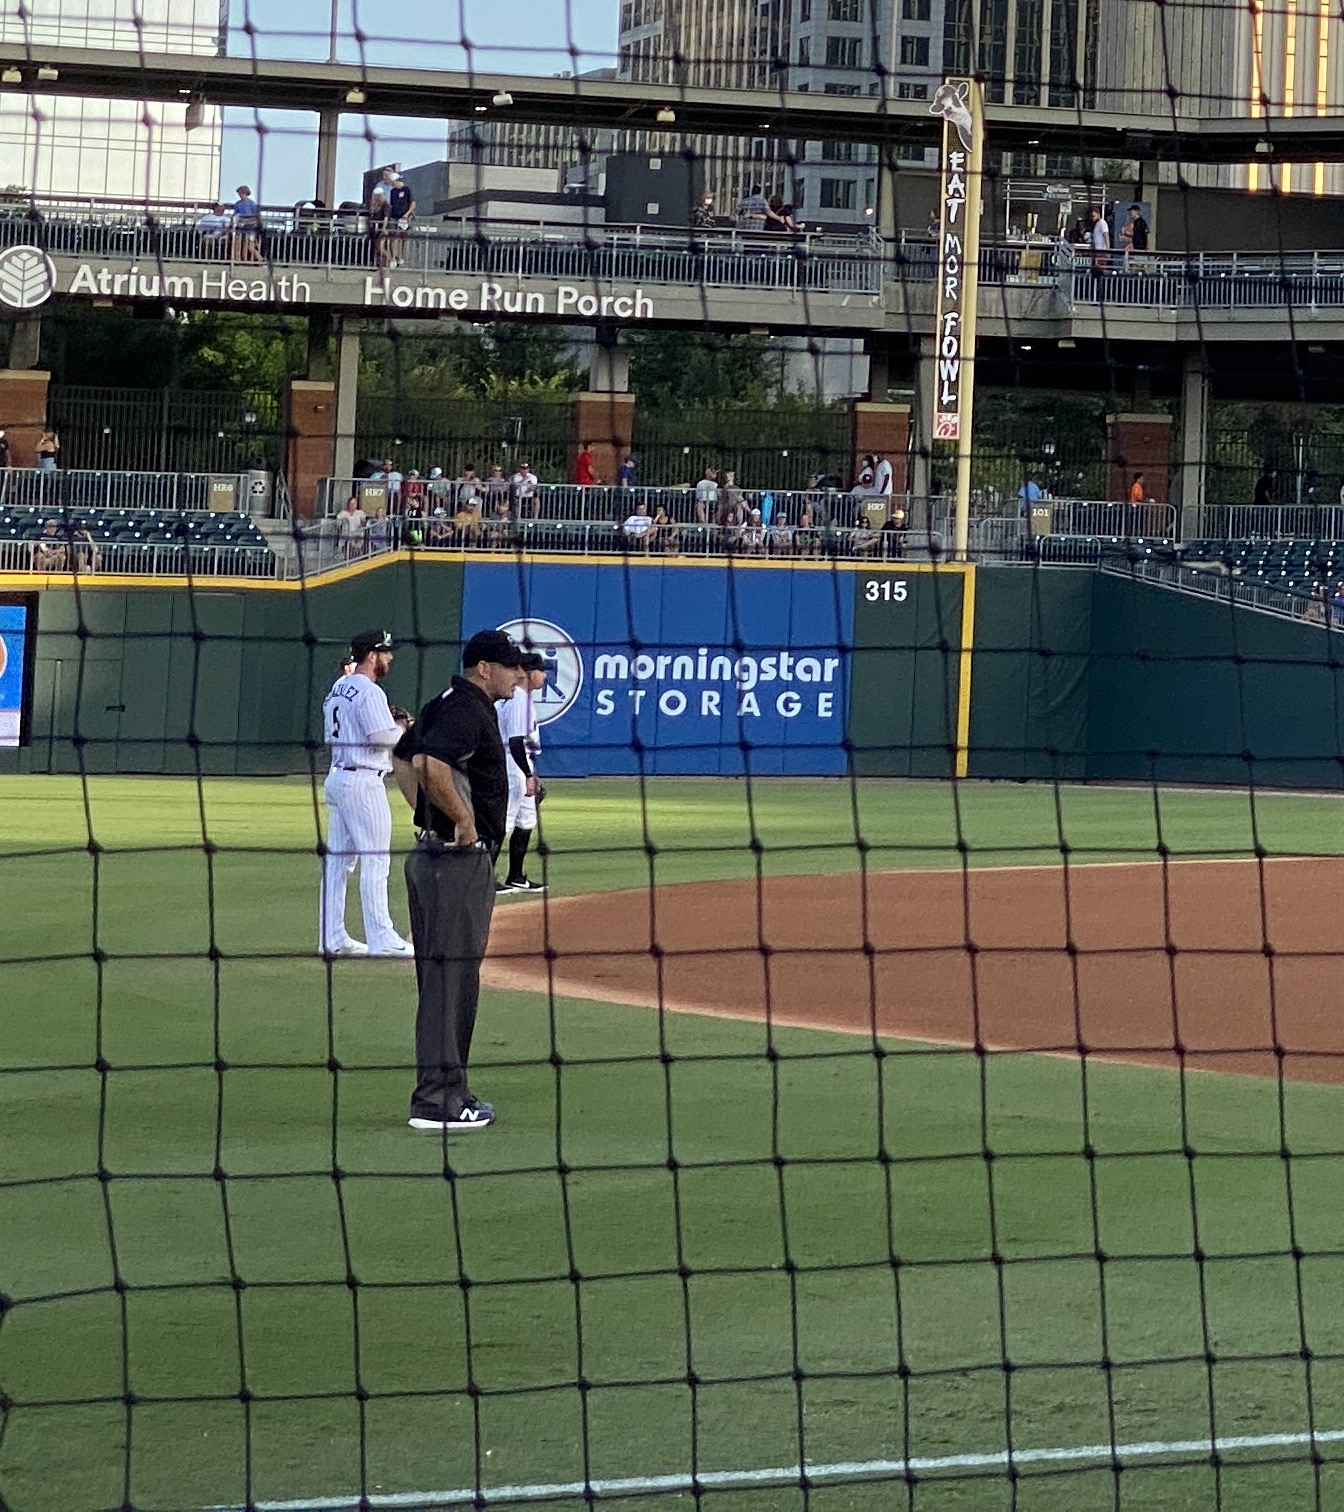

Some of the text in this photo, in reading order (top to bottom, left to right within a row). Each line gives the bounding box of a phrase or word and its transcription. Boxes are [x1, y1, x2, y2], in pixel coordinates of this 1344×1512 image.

[69, 264, 311, 303] Atrium Health
[363, 276, 654, 319] Home Run Porch
[940, 151, 966, 405] EAT MOR FOWL
[1032, 508, 1050, 517] 101
[865, 580, 908, 602] 315
[594, 647, 839, 690] morningstar
[596, 689, 834, 717] STORAGE
